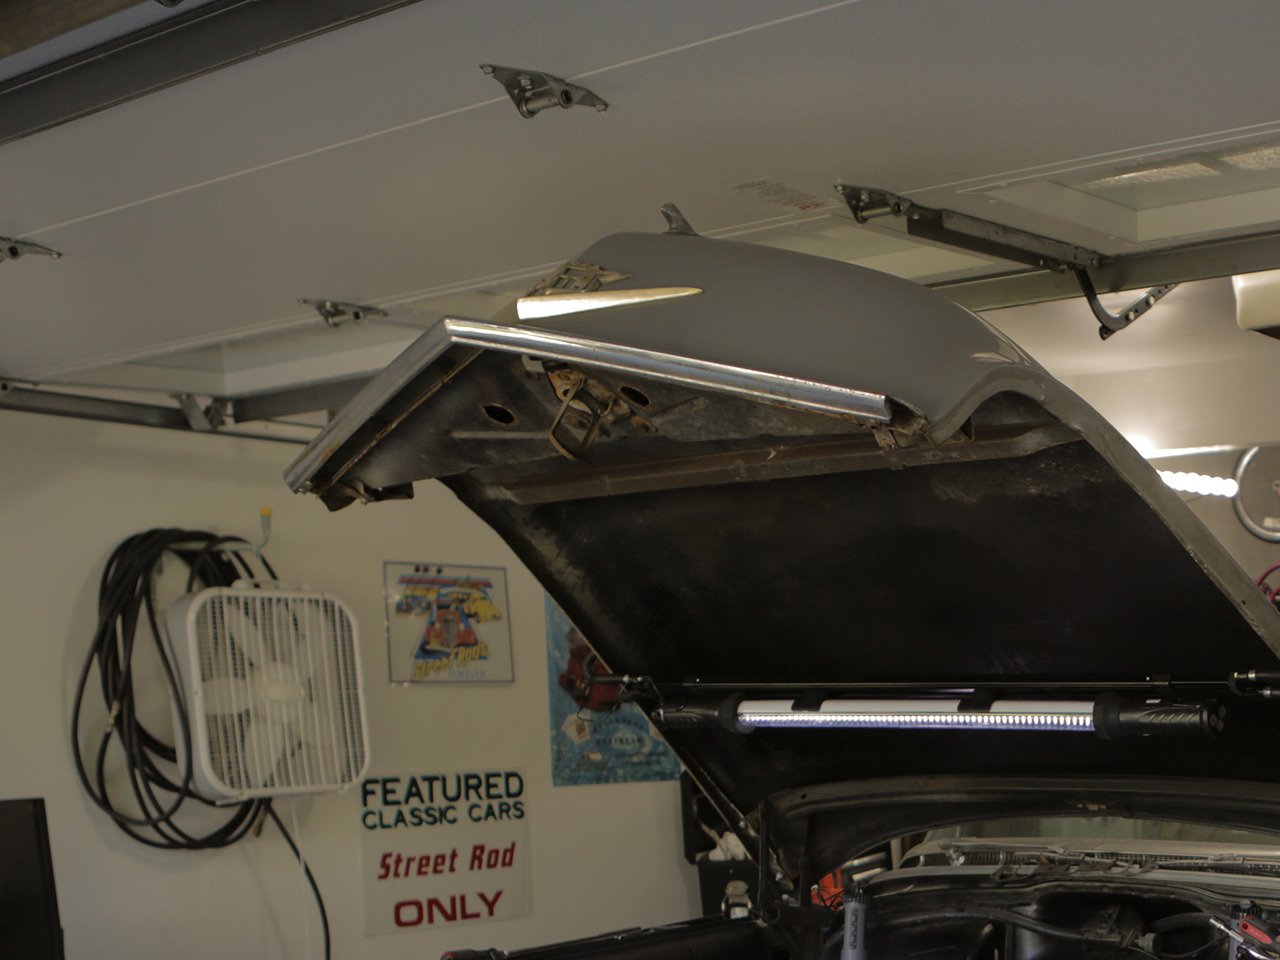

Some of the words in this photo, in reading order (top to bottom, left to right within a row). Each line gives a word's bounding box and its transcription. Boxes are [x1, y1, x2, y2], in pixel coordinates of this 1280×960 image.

[361, 771, 525, 807] FEATURED
[361, 805, 458, 830] CLASSIC
[467, 801, 525, 822] CARS
[377, 848, 458, 881] Street
[469, 841, 516, 871] Rod
[393, 889, 504, 928] ONLY
